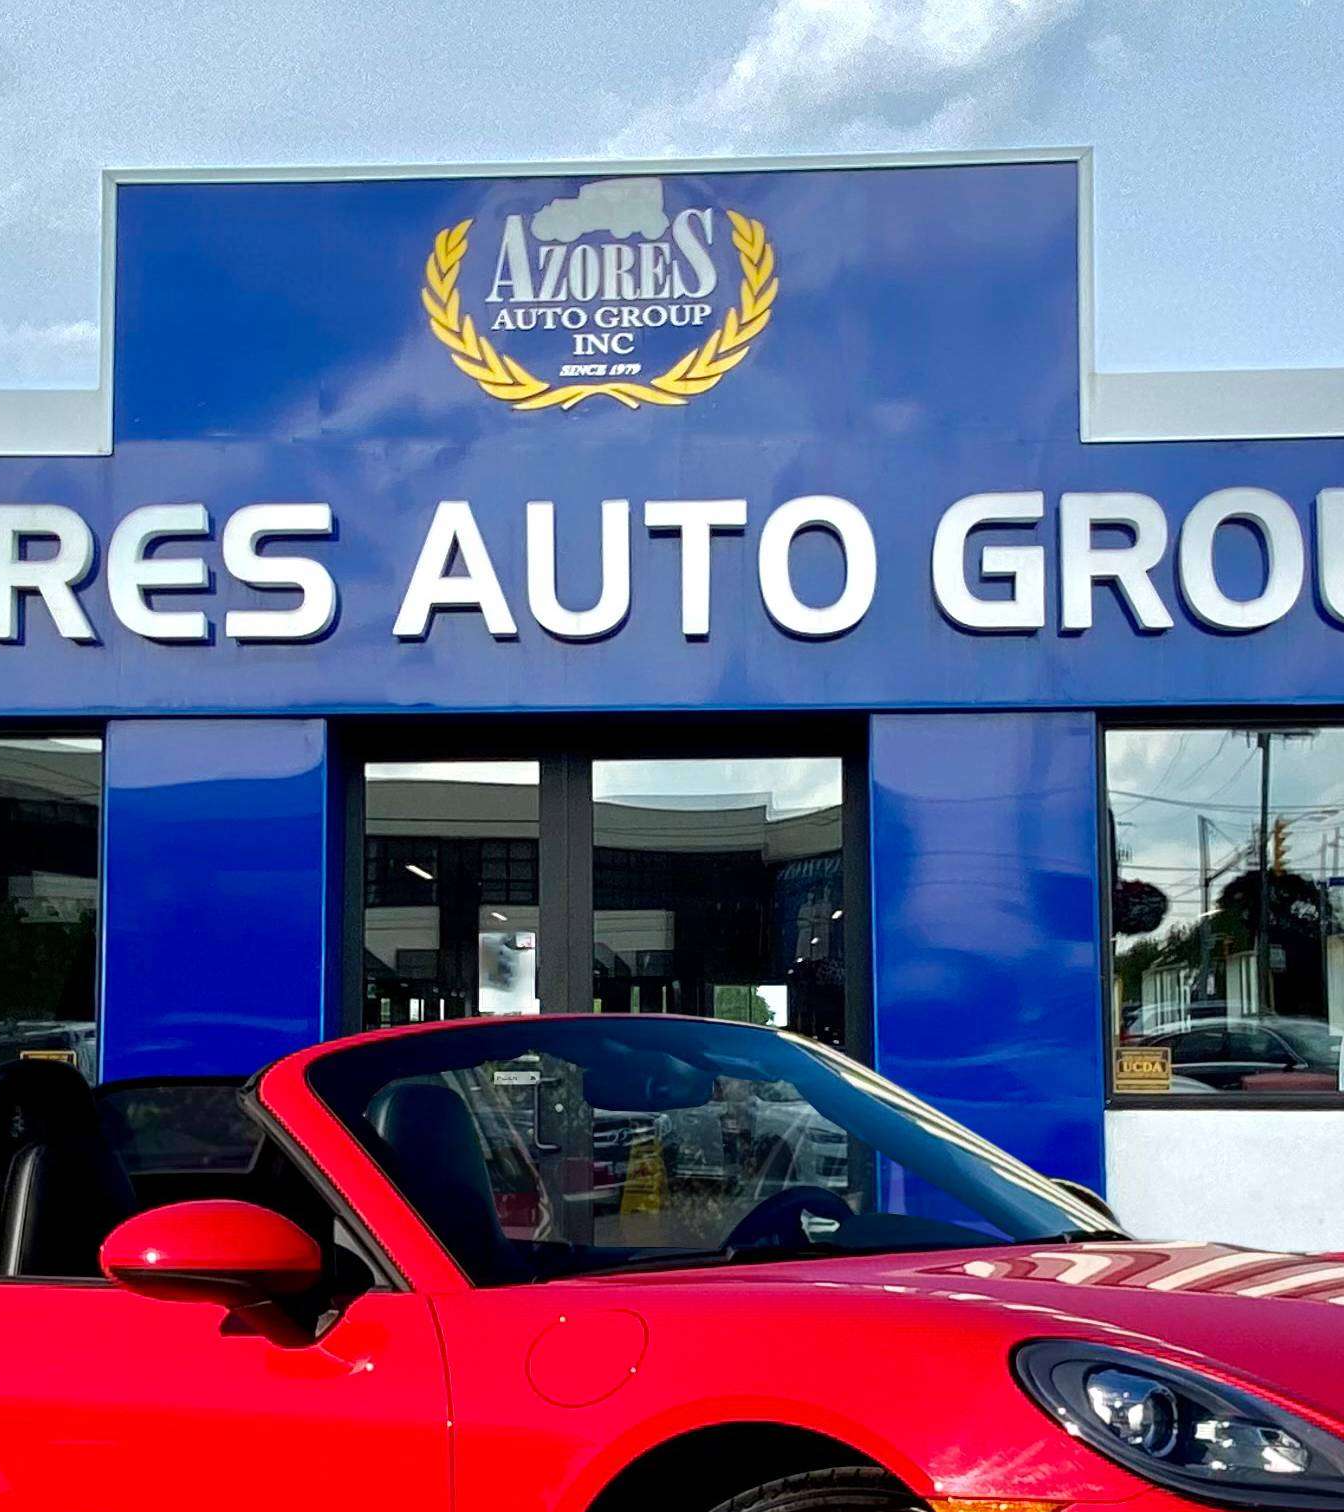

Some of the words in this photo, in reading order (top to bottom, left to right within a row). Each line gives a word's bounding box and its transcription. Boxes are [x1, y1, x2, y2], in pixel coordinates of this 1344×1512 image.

[485, 208, 718, 302] AZORES
[491, 306, 588, 330] AUTO
[594, 304, 712, 328] GROUP
[572, 332, 635, 355] INC
[559, 363, 608, 377] SINCE
[608, 363, 642, 376] 1979
[392, 495, 878, 642] AUTO
[1122, 1061, 1163, 1072] UCDA
